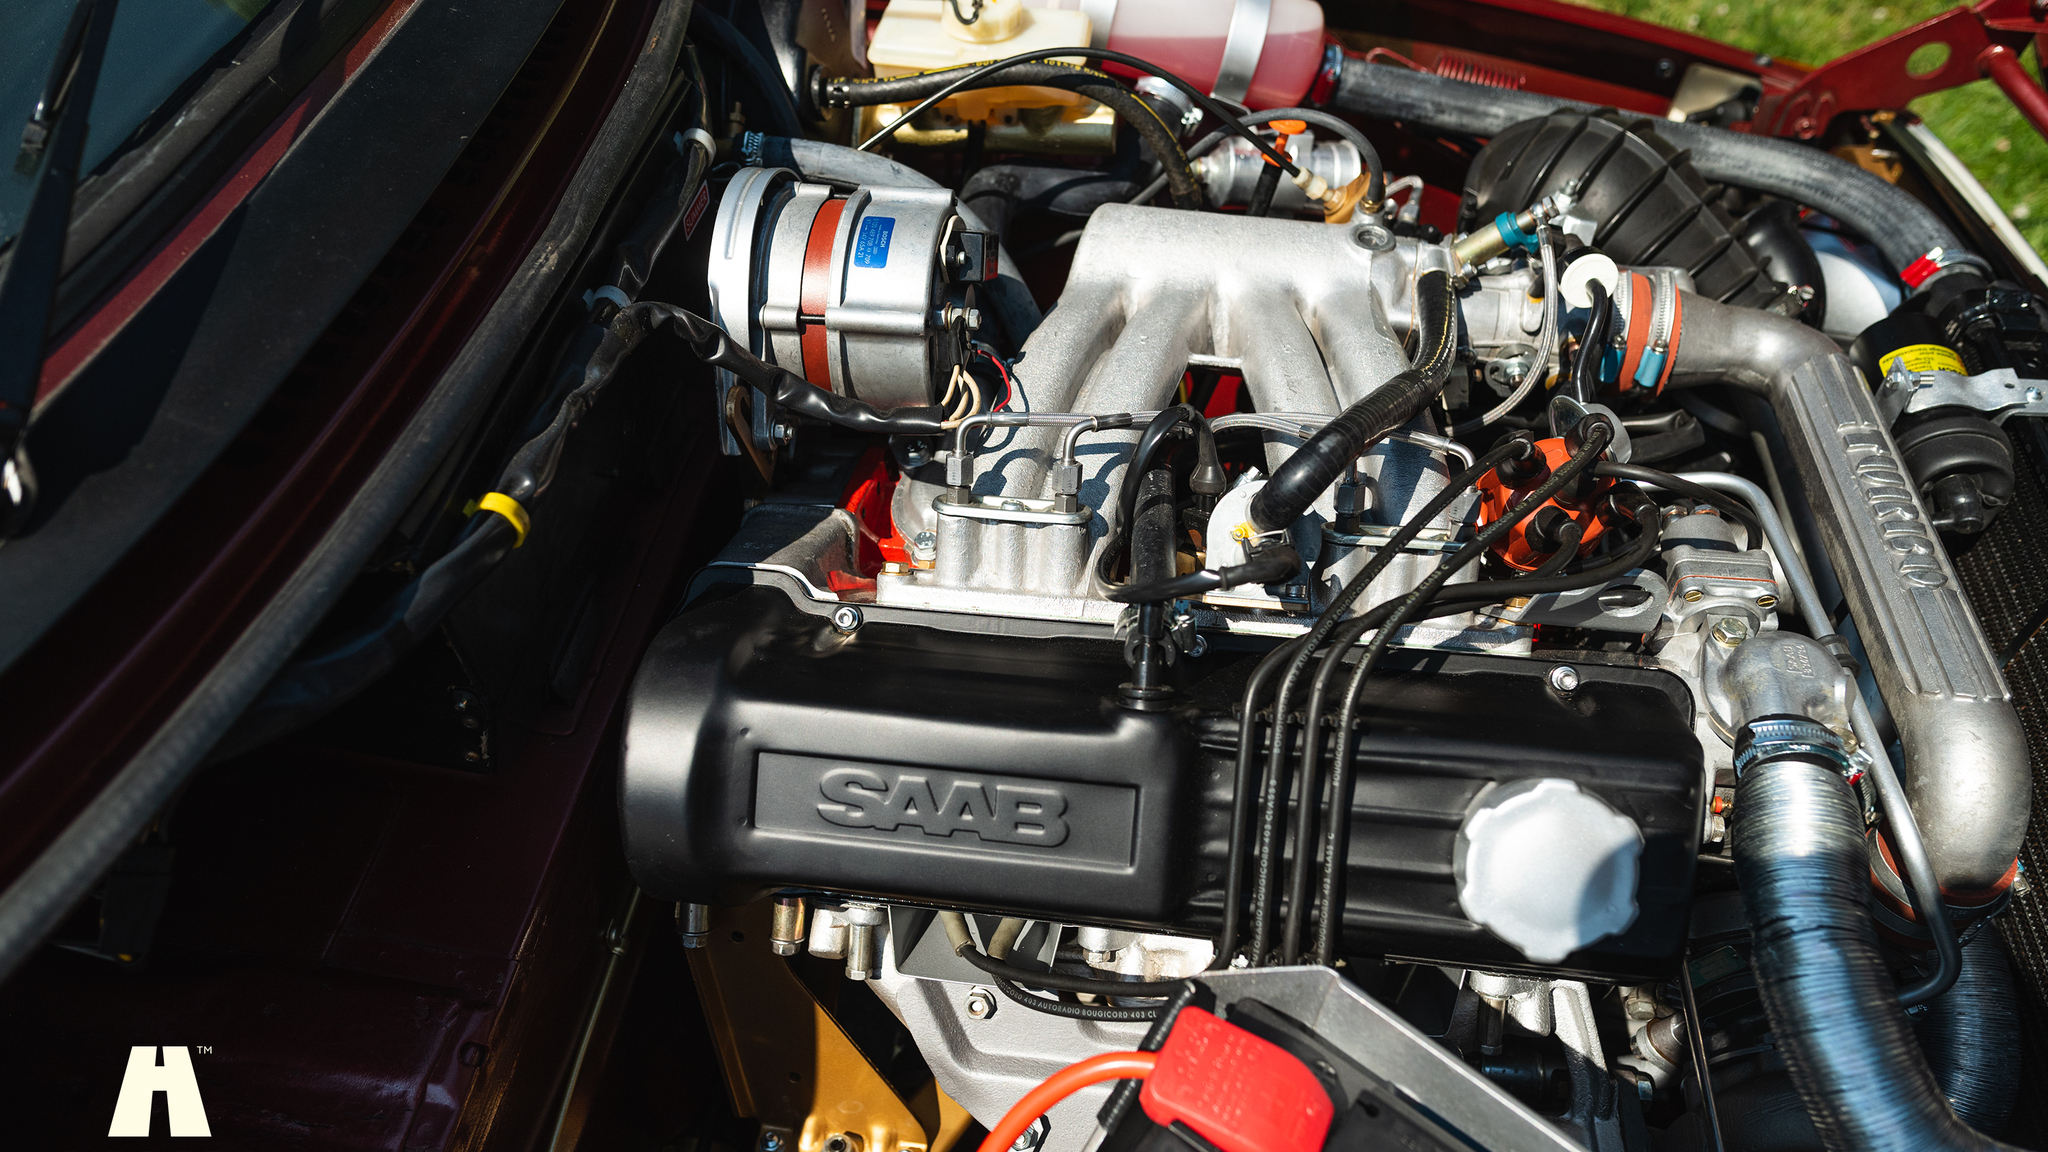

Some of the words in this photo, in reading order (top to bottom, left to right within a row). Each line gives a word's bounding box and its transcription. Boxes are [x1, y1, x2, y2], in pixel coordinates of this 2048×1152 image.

[685, 190, 708, 232] SUMMER
[880, 231, 888, 247] BOSCH
[1475, 511, 1515, 542] BOUGICORD
[1514, 501, 1527, 513] 403
[1527, 476, 1559, 503] AUTORADIO
[1842, 428, 1949, 589] TURBO
[1418, 569, 1442, 592] CLASS
[1440, 562, 1450, 571] C
[1331, 577, 1372, 621] BOUGICORD
[1405, 590, 1421, 605] 403
[1367, 604, 1406, 651] BOUGICORD
[1273, 691, 1291, 754] BOUGICORD
[1287, 669, 1300, 688] 403
[1296, 619, 1335, 669] AUTORADIO
[1343, 652, 1372, 706] AUTORADIO
[1339, 709, 1349, 727] 403
[1332, 731, 1345, 786] BOUGICORD
[817, 767, 1070, 848] SAAB
[1264, 787, 1276, 821] CLASS
[1262, 823, 1271, 843] 403
[1257, 846, 1269, 906] BOUGICORD
[1323, 845, 1334, 873] CLASS
[1322, 878, 1331, 895] 403
[1250, 909, 1263, 968] AUTORADIO
[1318, 899, 1329, 954] BOUGICORD
[993, 975, 1022, 1000] OUGICORD
[1024, 996, 1037, 1005] 403
[1038, 1001, 1080, 1015] AUTORADIO
[1082, 1009, 1128, 1019] BOUGICORD
